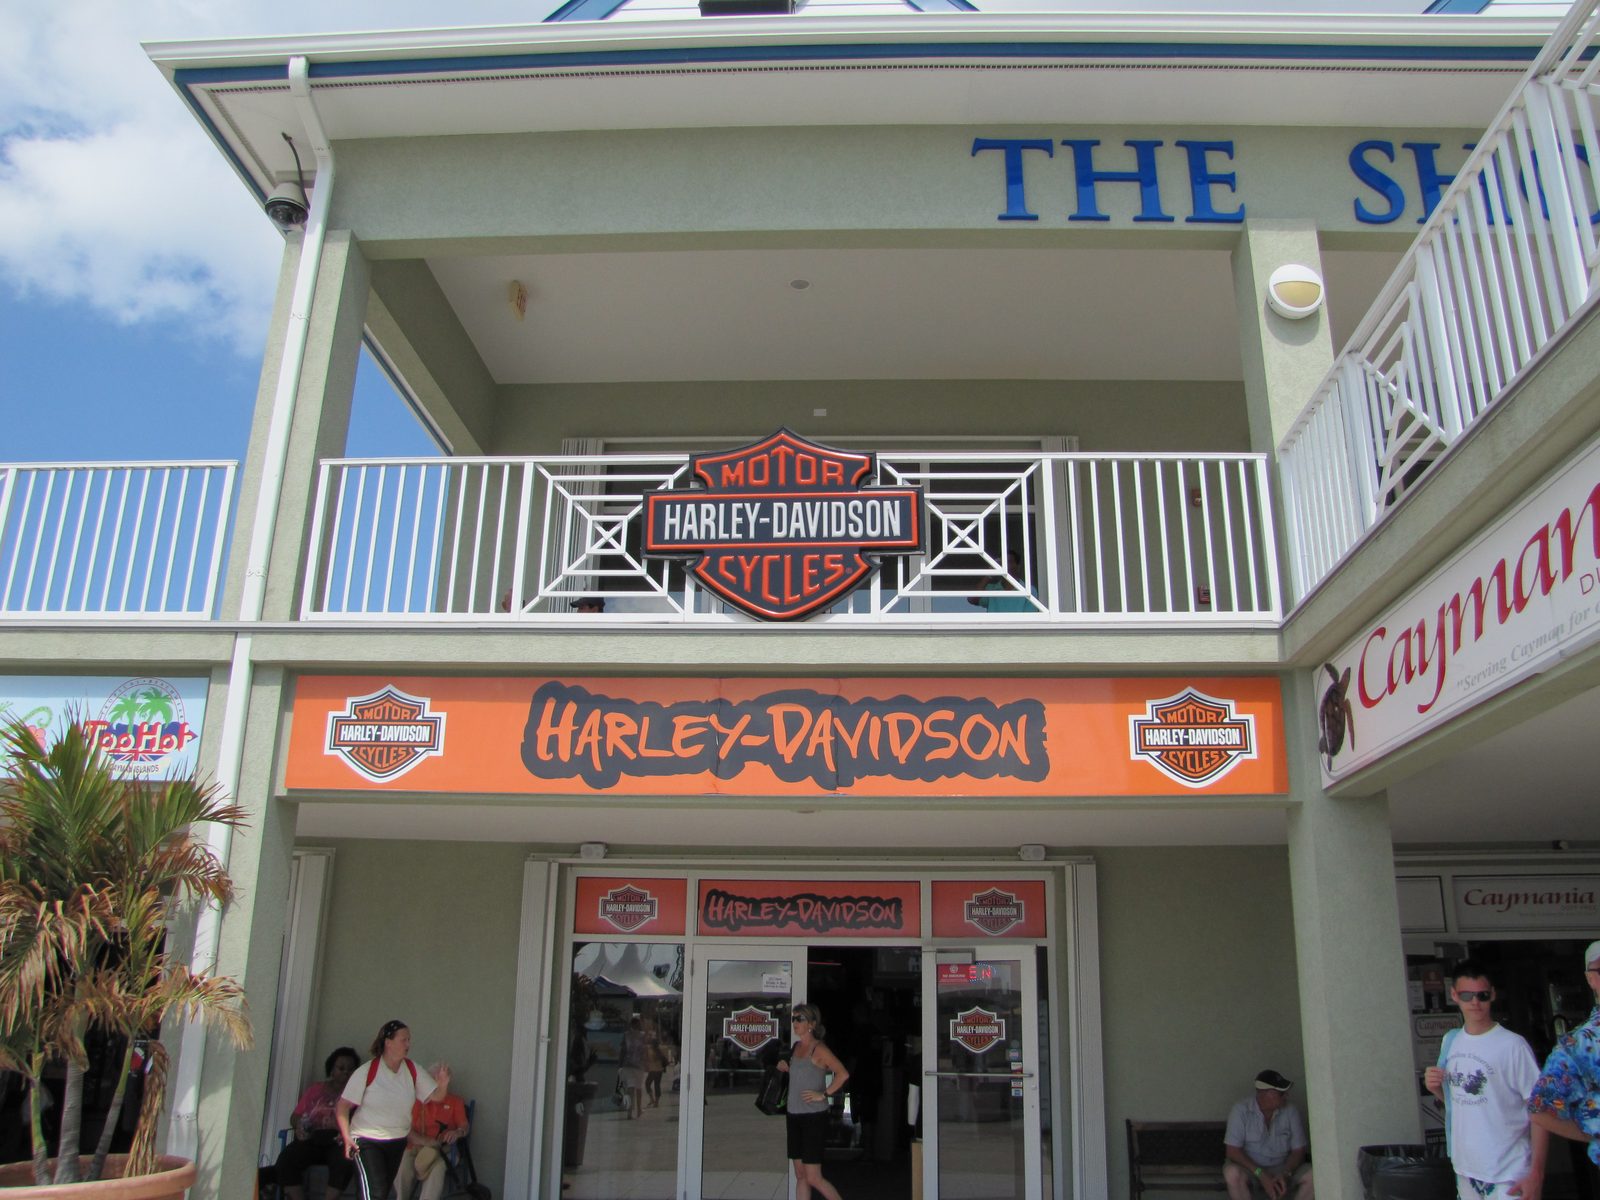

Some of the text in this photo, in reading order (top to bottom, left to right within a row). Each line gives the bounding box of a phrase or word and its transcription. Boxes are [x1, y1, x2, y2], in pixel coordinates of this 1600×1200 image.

[971, 137, 1246, 224] THE
[721, 445, 844, 488] MOTOR
[664, 499, 901, 541] HARLEY-DAVIDSON
[717, 553, 846, 606] CYCLES
[1568, 608, 1591, 635] for
[363, 701, 411, 721] MOTOR
[1166, 704, 1217, 723] MOTOR
[340, 724, 431, 743] HARLEY-DAVIDSON
[535, 697, 1030, 772] HARLEY-DAVIDSON
[1145, 728, 1241, 746] HARLEY-DAVIDSON
[358, 746, 408, 768] CYCLES
[1167, 751, 1220, 773] CYCLES
[606, 903, 651, 912] HARLEY-DAVIDSON
[707, 895, 897, 926] HARLEY-DAVIDSON
[971, 907, 1018, 916] HARLEY-DAVIDSON
[1463, 887, 1595, 913] Caymania
